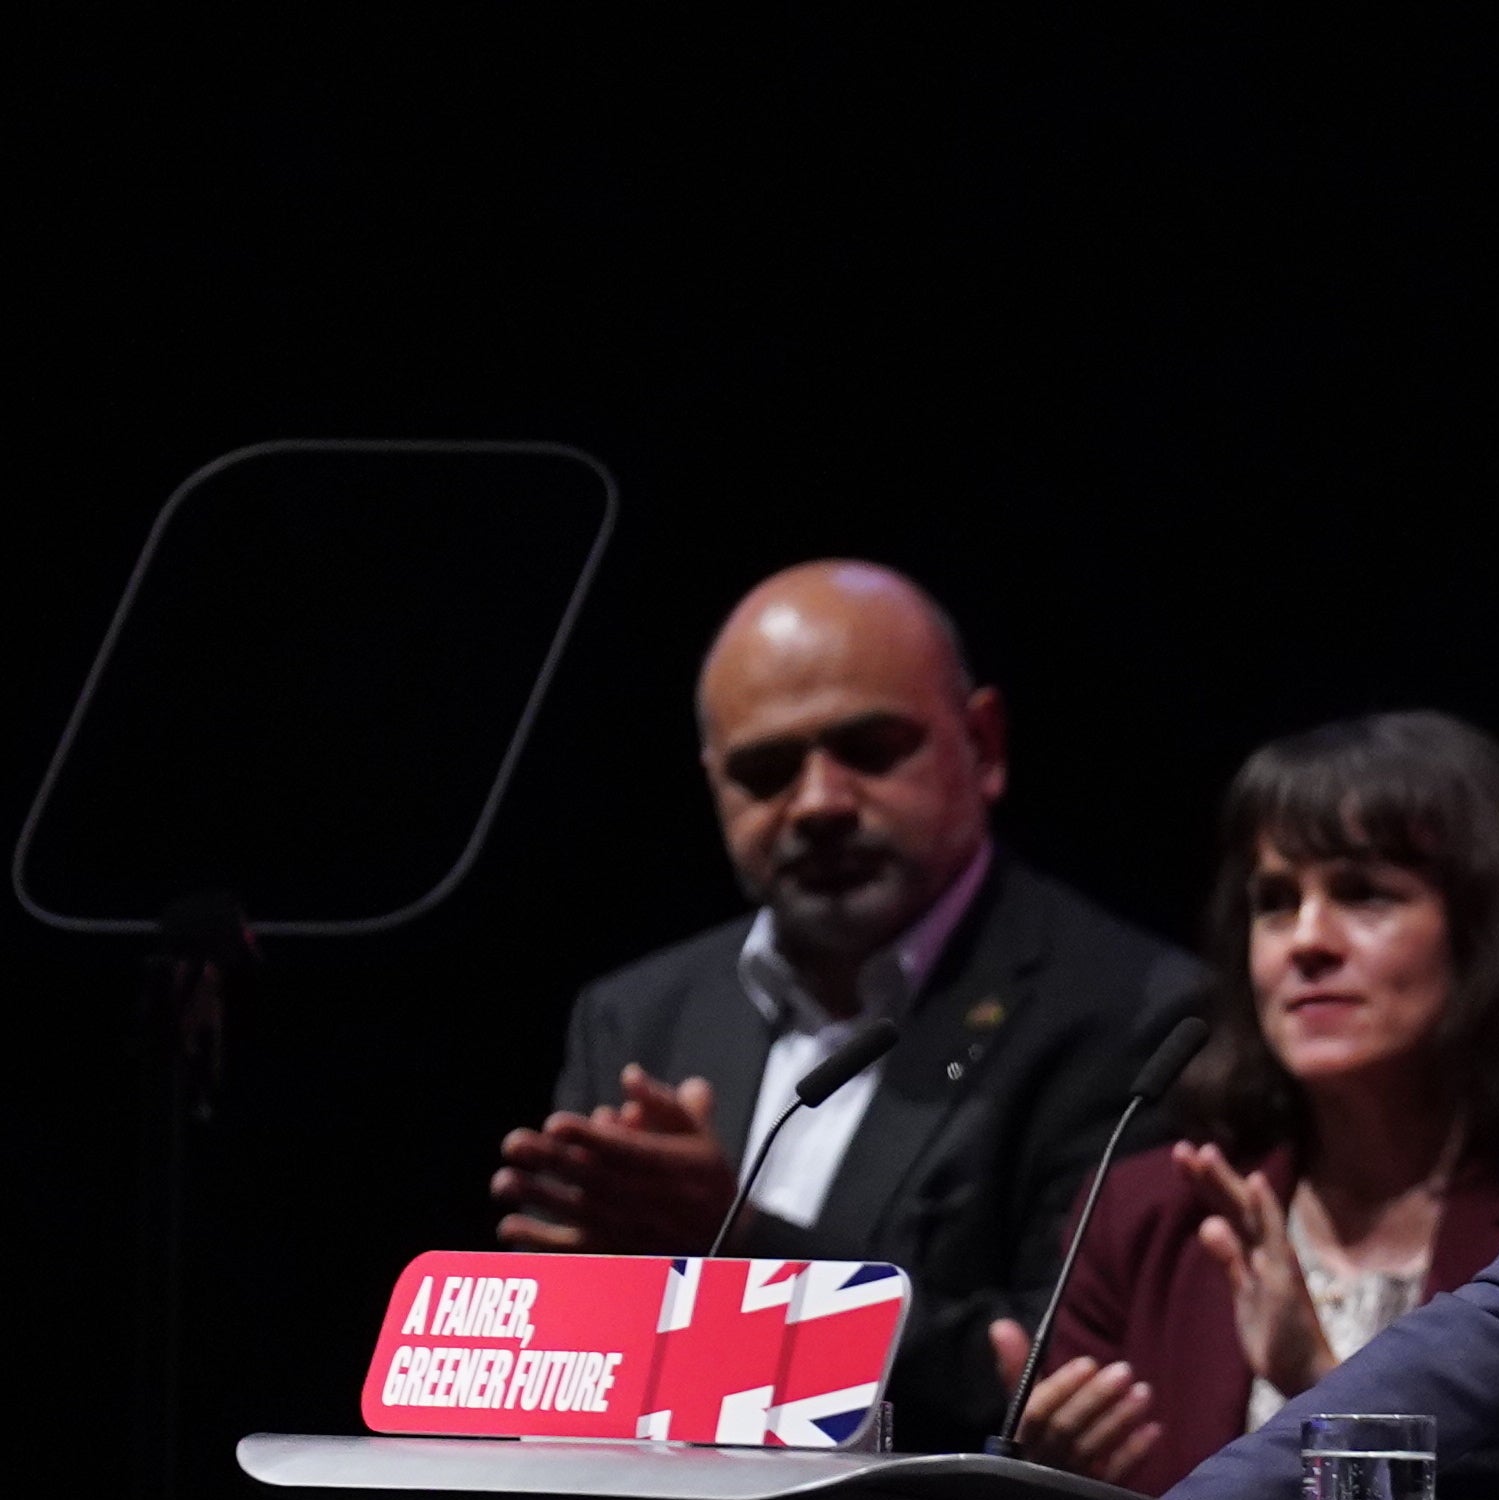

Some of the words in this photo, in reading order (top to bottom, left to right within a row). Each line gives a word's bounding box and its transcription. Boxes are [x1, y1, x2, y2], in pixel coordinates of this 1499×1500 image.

[402, 1276, 432, 1335] A
[430, 1276, 538, 1347] FAIRER,
[381, 1347, 514, 1409] GREENER
[508, 1350, 622, 1413] FUTURE
